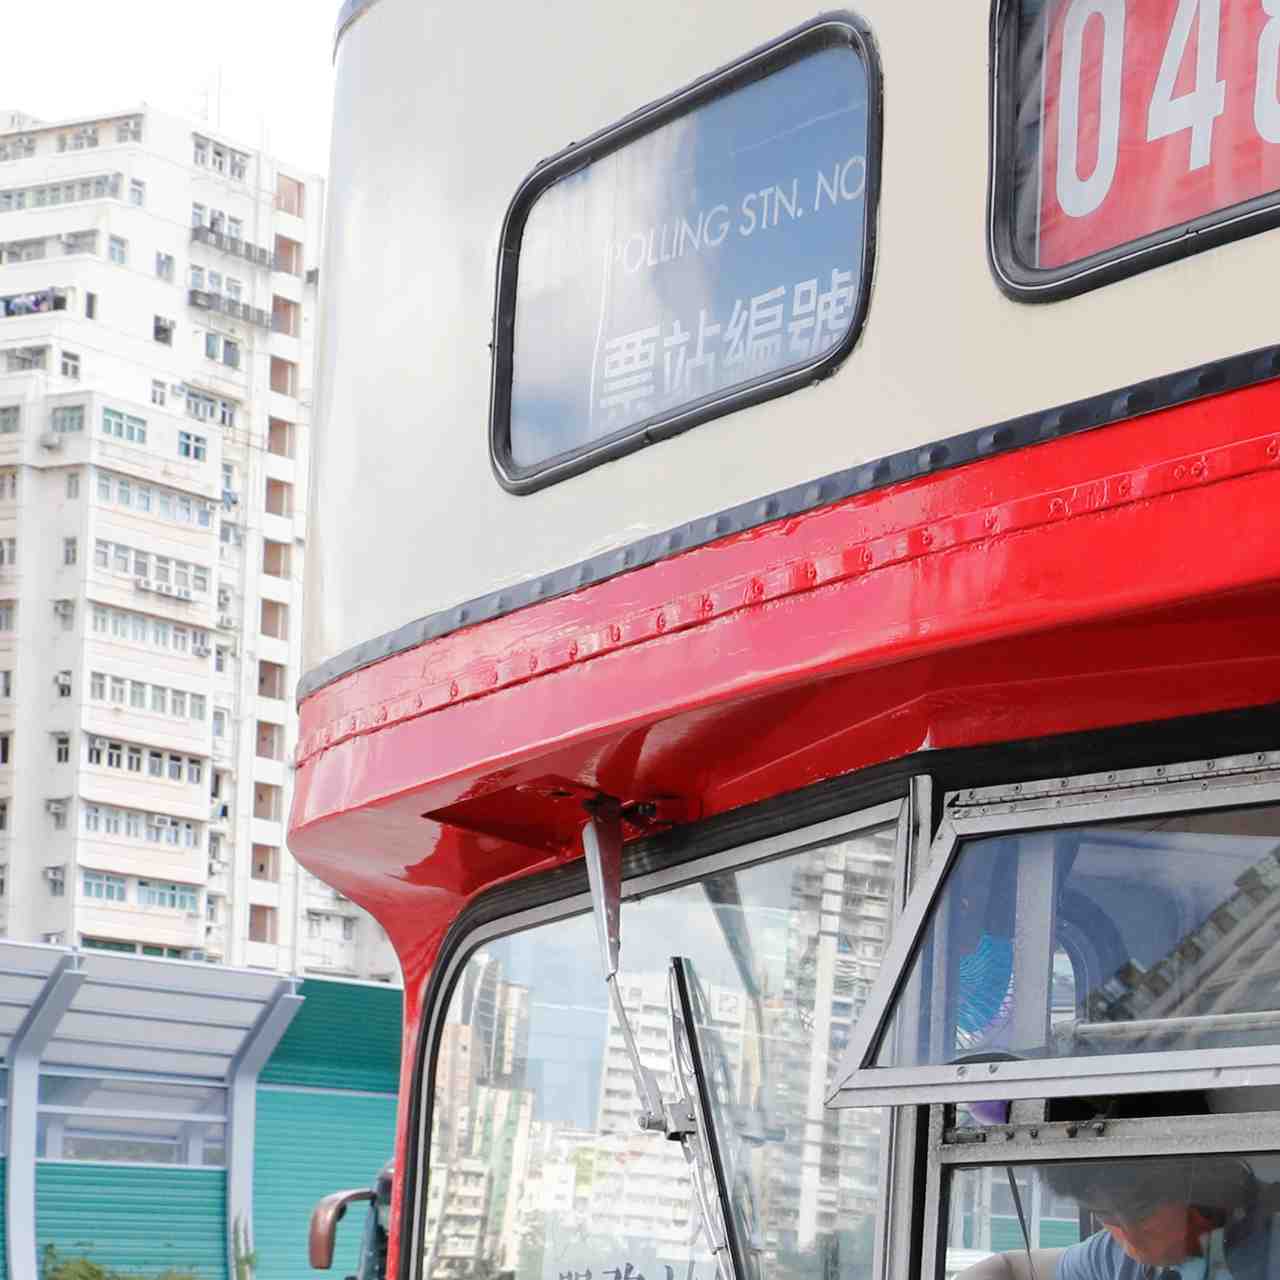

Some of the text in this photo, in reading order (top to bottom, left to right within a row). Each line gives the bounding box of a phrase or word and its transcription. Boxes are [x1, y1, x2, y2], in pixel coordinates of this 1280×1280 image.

[604, 203, 729, 274] POLLING
[740, 178, 803, 236] STN.
[600, 268, 855, 418] 票站編號
